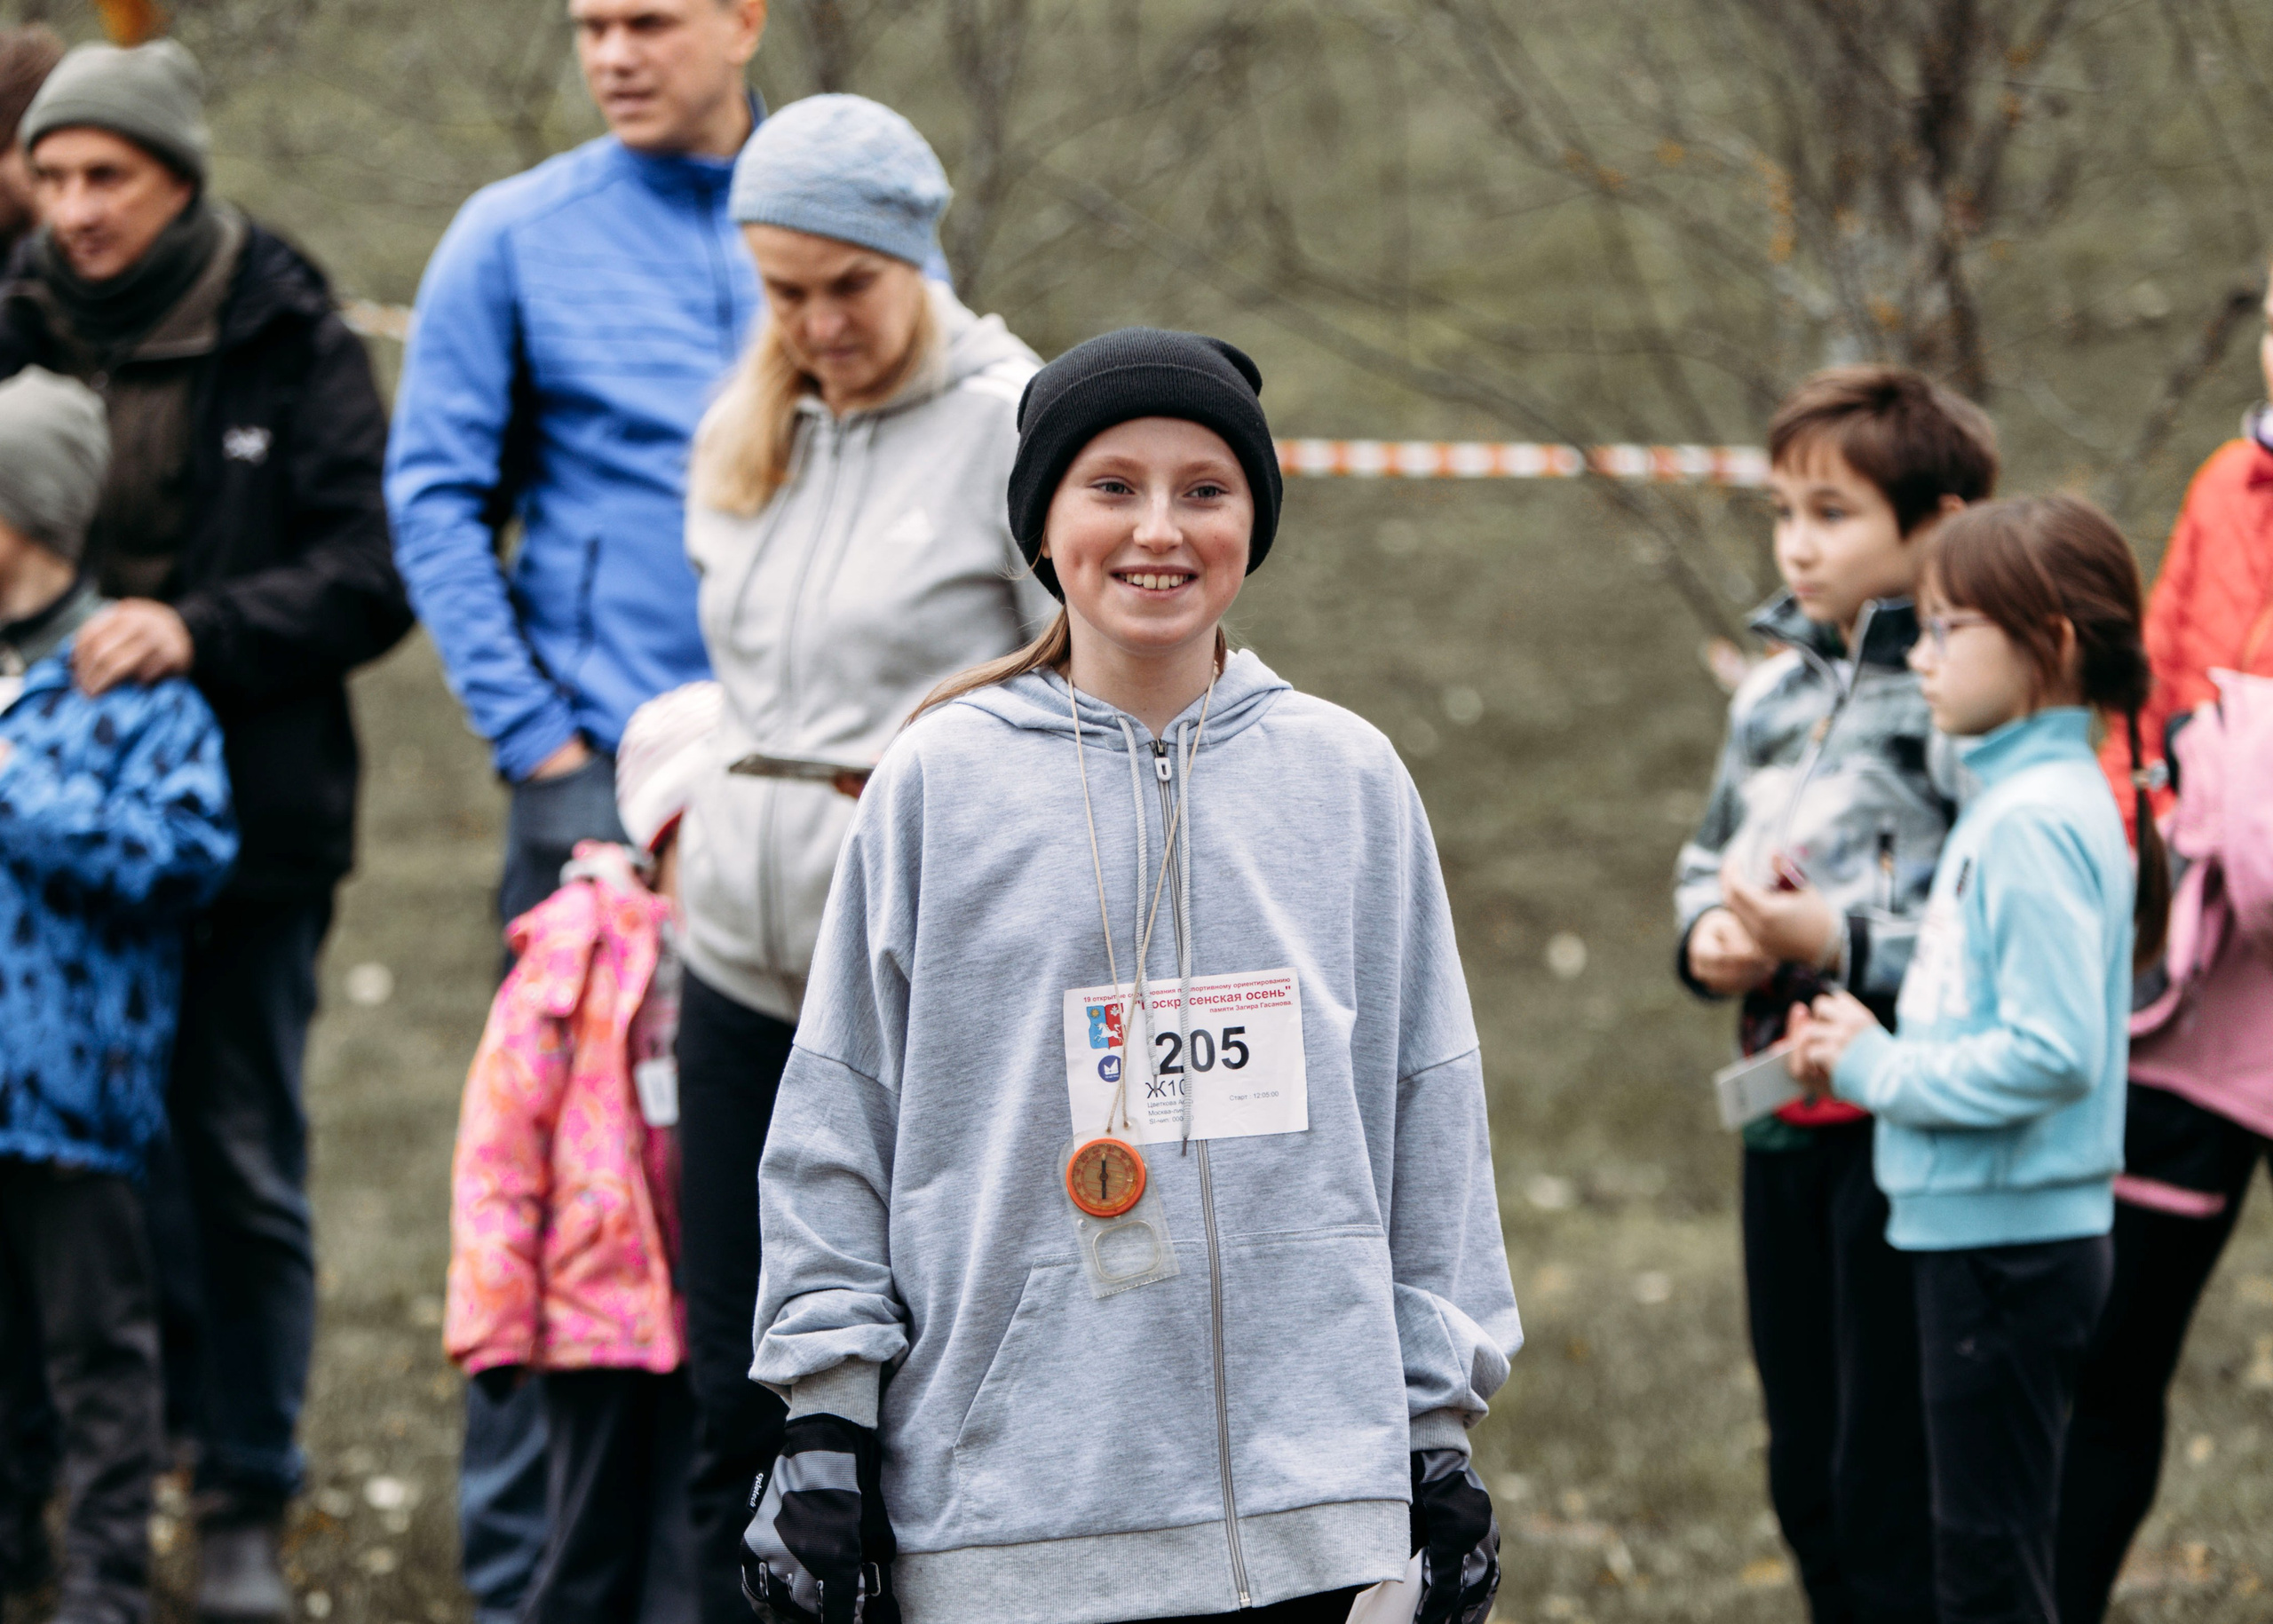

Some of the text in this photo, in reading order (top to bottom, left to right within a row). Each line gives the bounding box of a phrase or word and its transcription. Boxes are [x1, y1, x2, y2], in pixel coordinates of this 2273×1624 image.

[1233, 978, 1290, 988] ориентированию
[1246, 986, 1291, 1001] осень"
[1155, 1026, 1250, 1074] 205
